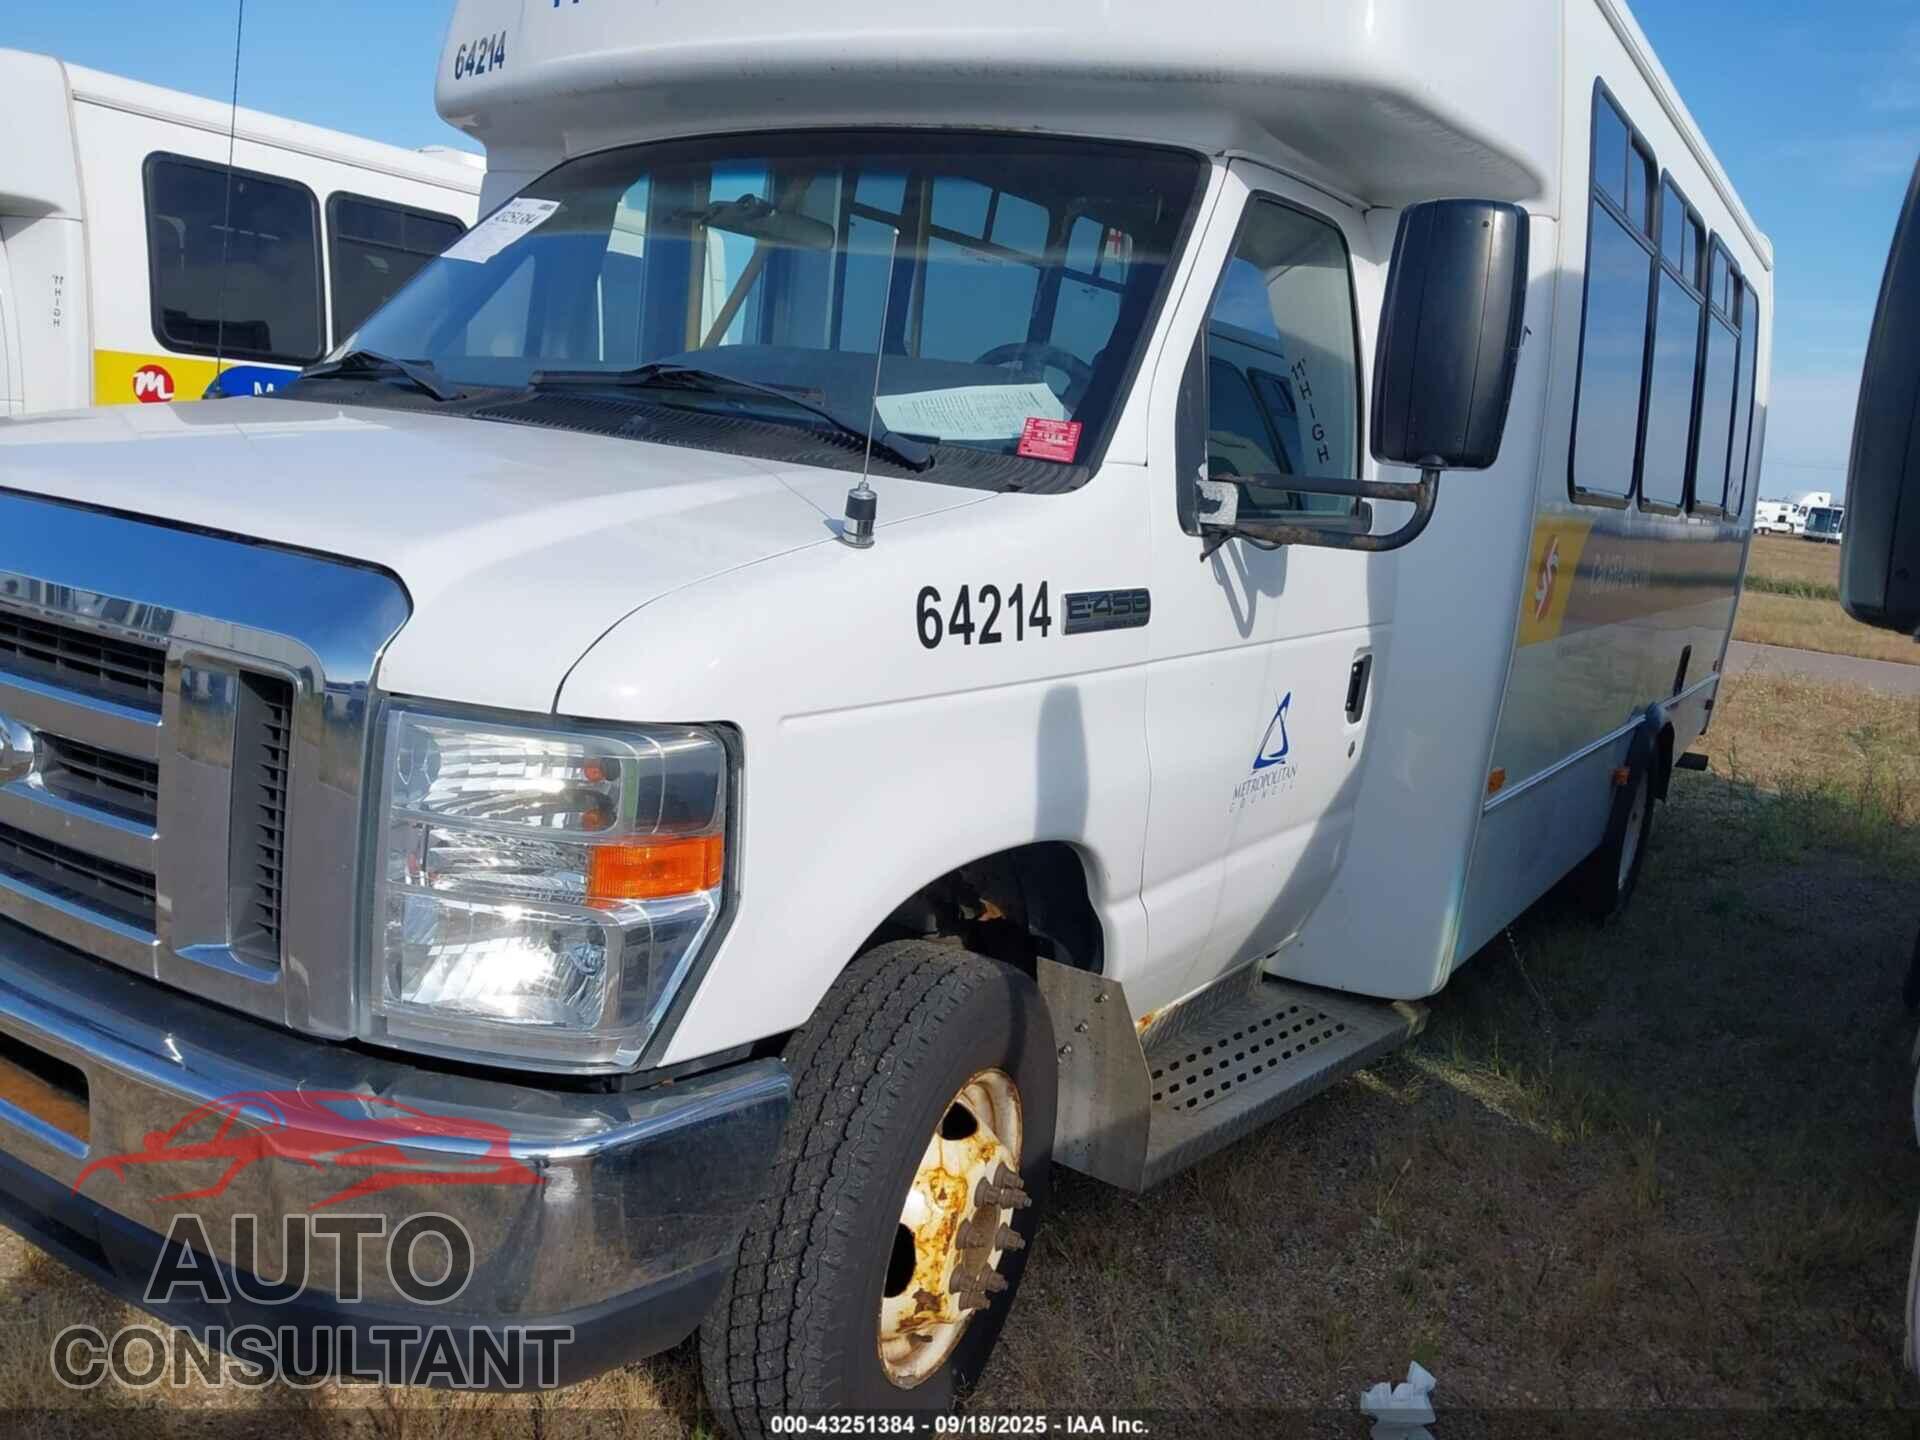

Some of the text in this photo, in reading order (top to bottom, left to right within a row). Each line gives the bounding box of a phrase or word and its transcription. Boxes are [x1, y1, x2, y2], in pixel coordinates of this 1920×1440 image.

[454, 30, 506, 80] 64214
[1299, 380, 1330, 465] HIGH
[916, 580, 1052, 649] 64214
[1231, 764, 1298, 801] METROPOLITAN
